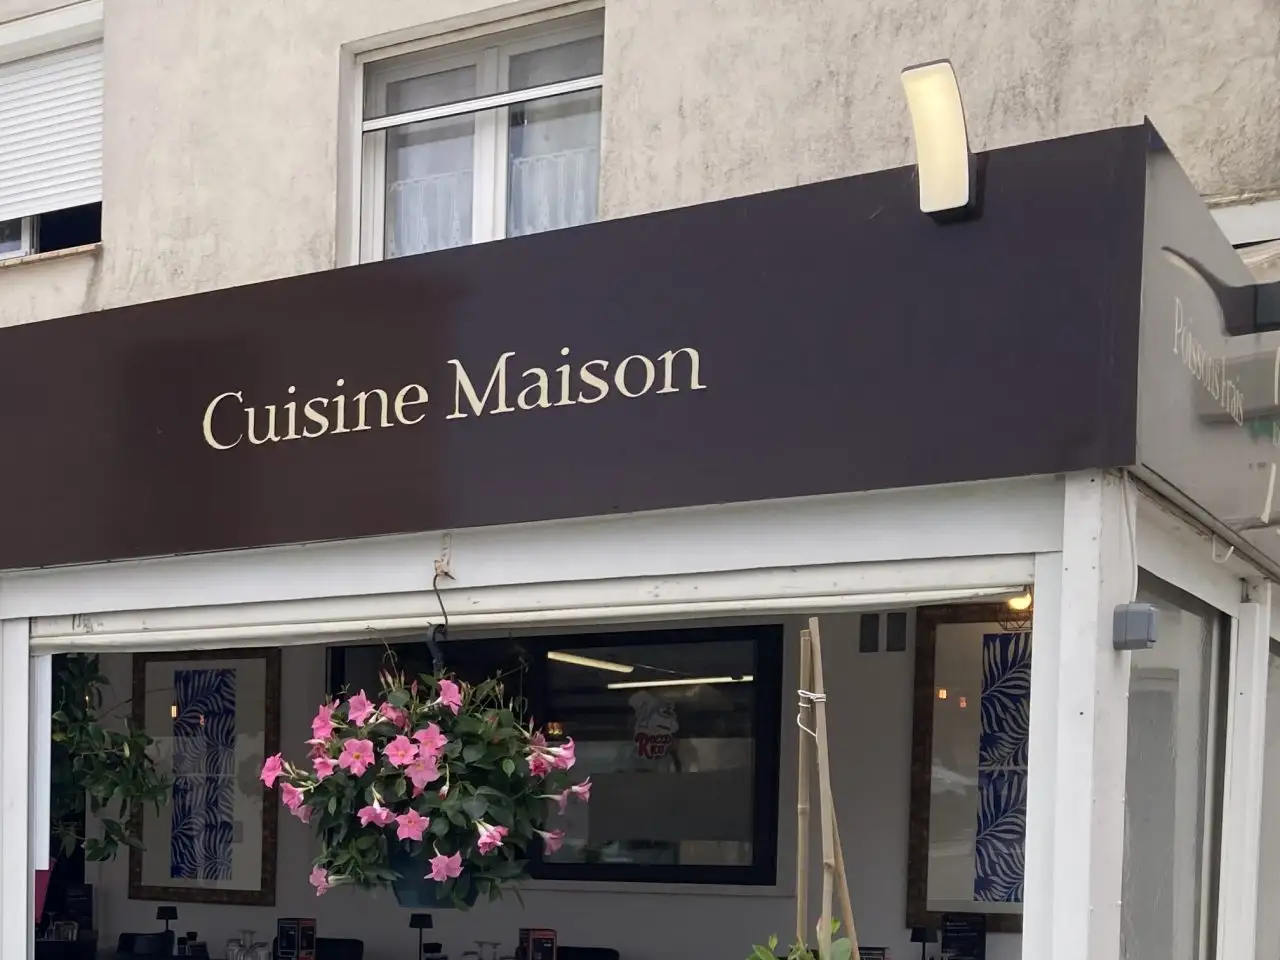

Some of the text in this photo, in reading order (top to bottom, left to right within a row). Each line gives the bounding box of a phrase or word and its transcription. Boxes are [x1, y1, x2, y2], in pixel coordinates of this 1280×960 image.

[202, 347, 707, 450] Cuisine Maison
[1173, 296, 1245, 427] Poissons Frais
